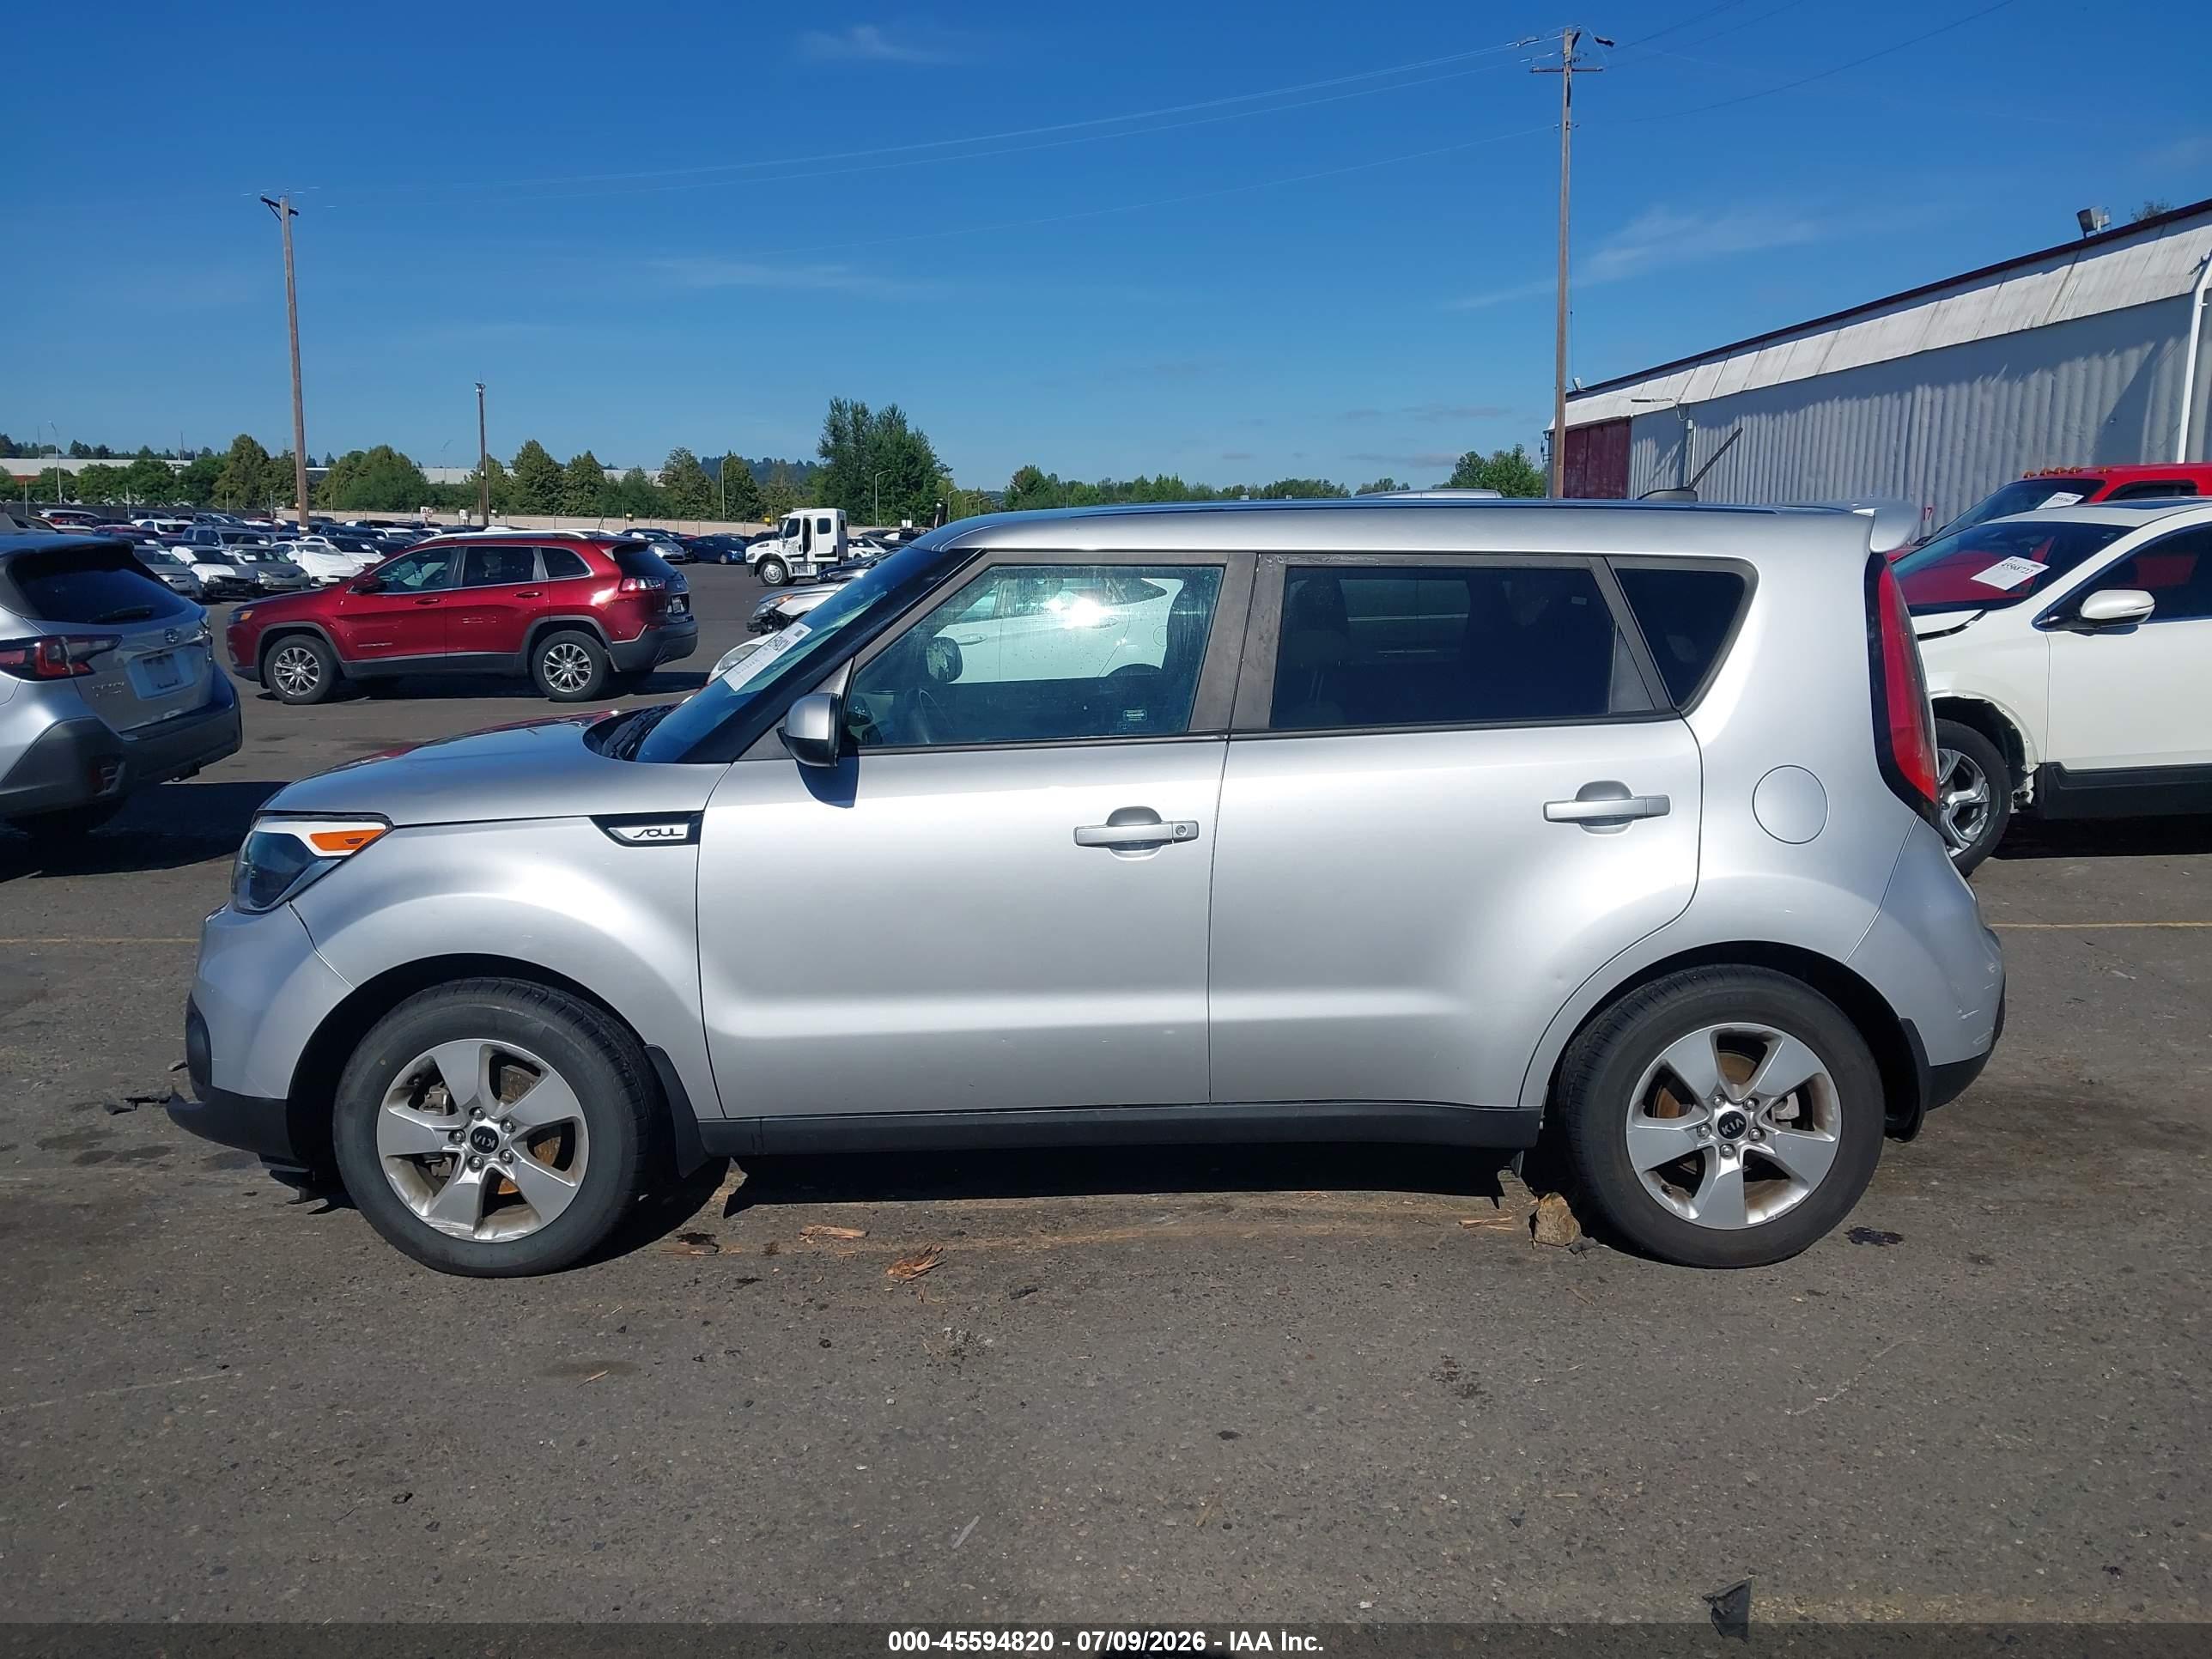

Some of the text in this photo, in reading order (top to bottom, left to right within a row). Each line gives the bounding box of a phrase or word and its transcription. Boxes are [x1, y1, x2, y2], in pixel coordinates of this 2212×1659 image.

[1923, 507, 1933, 521] 17
[633, 828, 684, 838] SOUL
[1721, 1118, 1744, 1135] KIA
[474, 1133, 495, 1148] KIA
